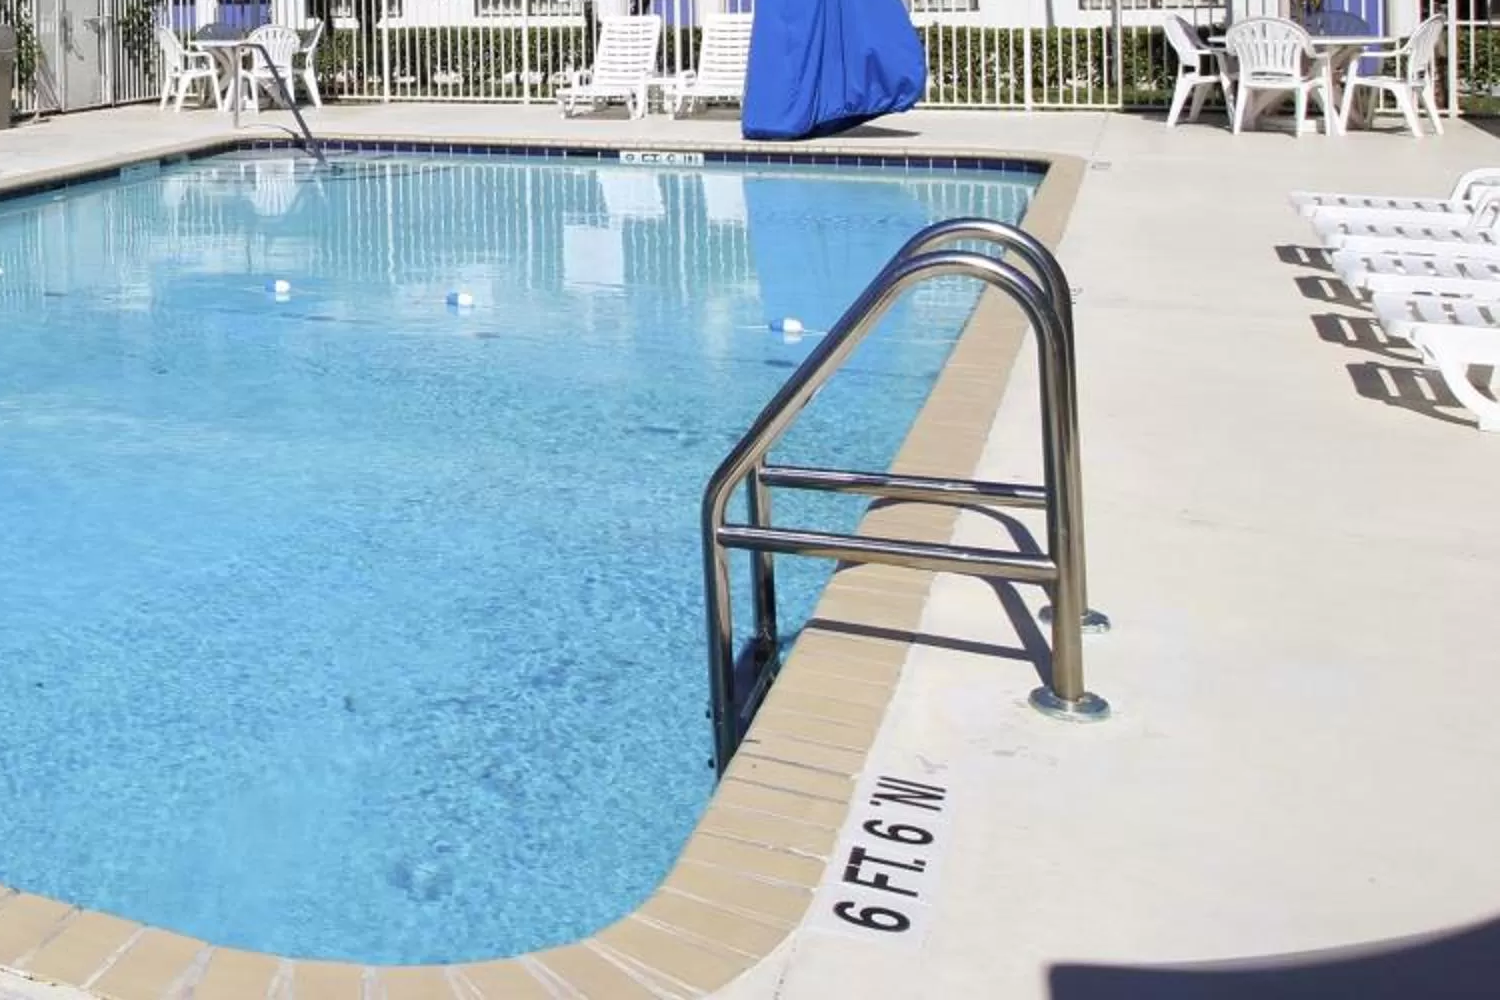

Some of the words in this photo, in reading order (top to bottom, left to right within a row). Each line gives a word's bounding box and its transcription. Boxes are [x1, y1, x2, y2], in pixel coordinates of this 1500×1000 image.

[861, 818, 935, 846] 6
[841, 846, 928, 898] FT.
[831, 900, 911, 933] 6
